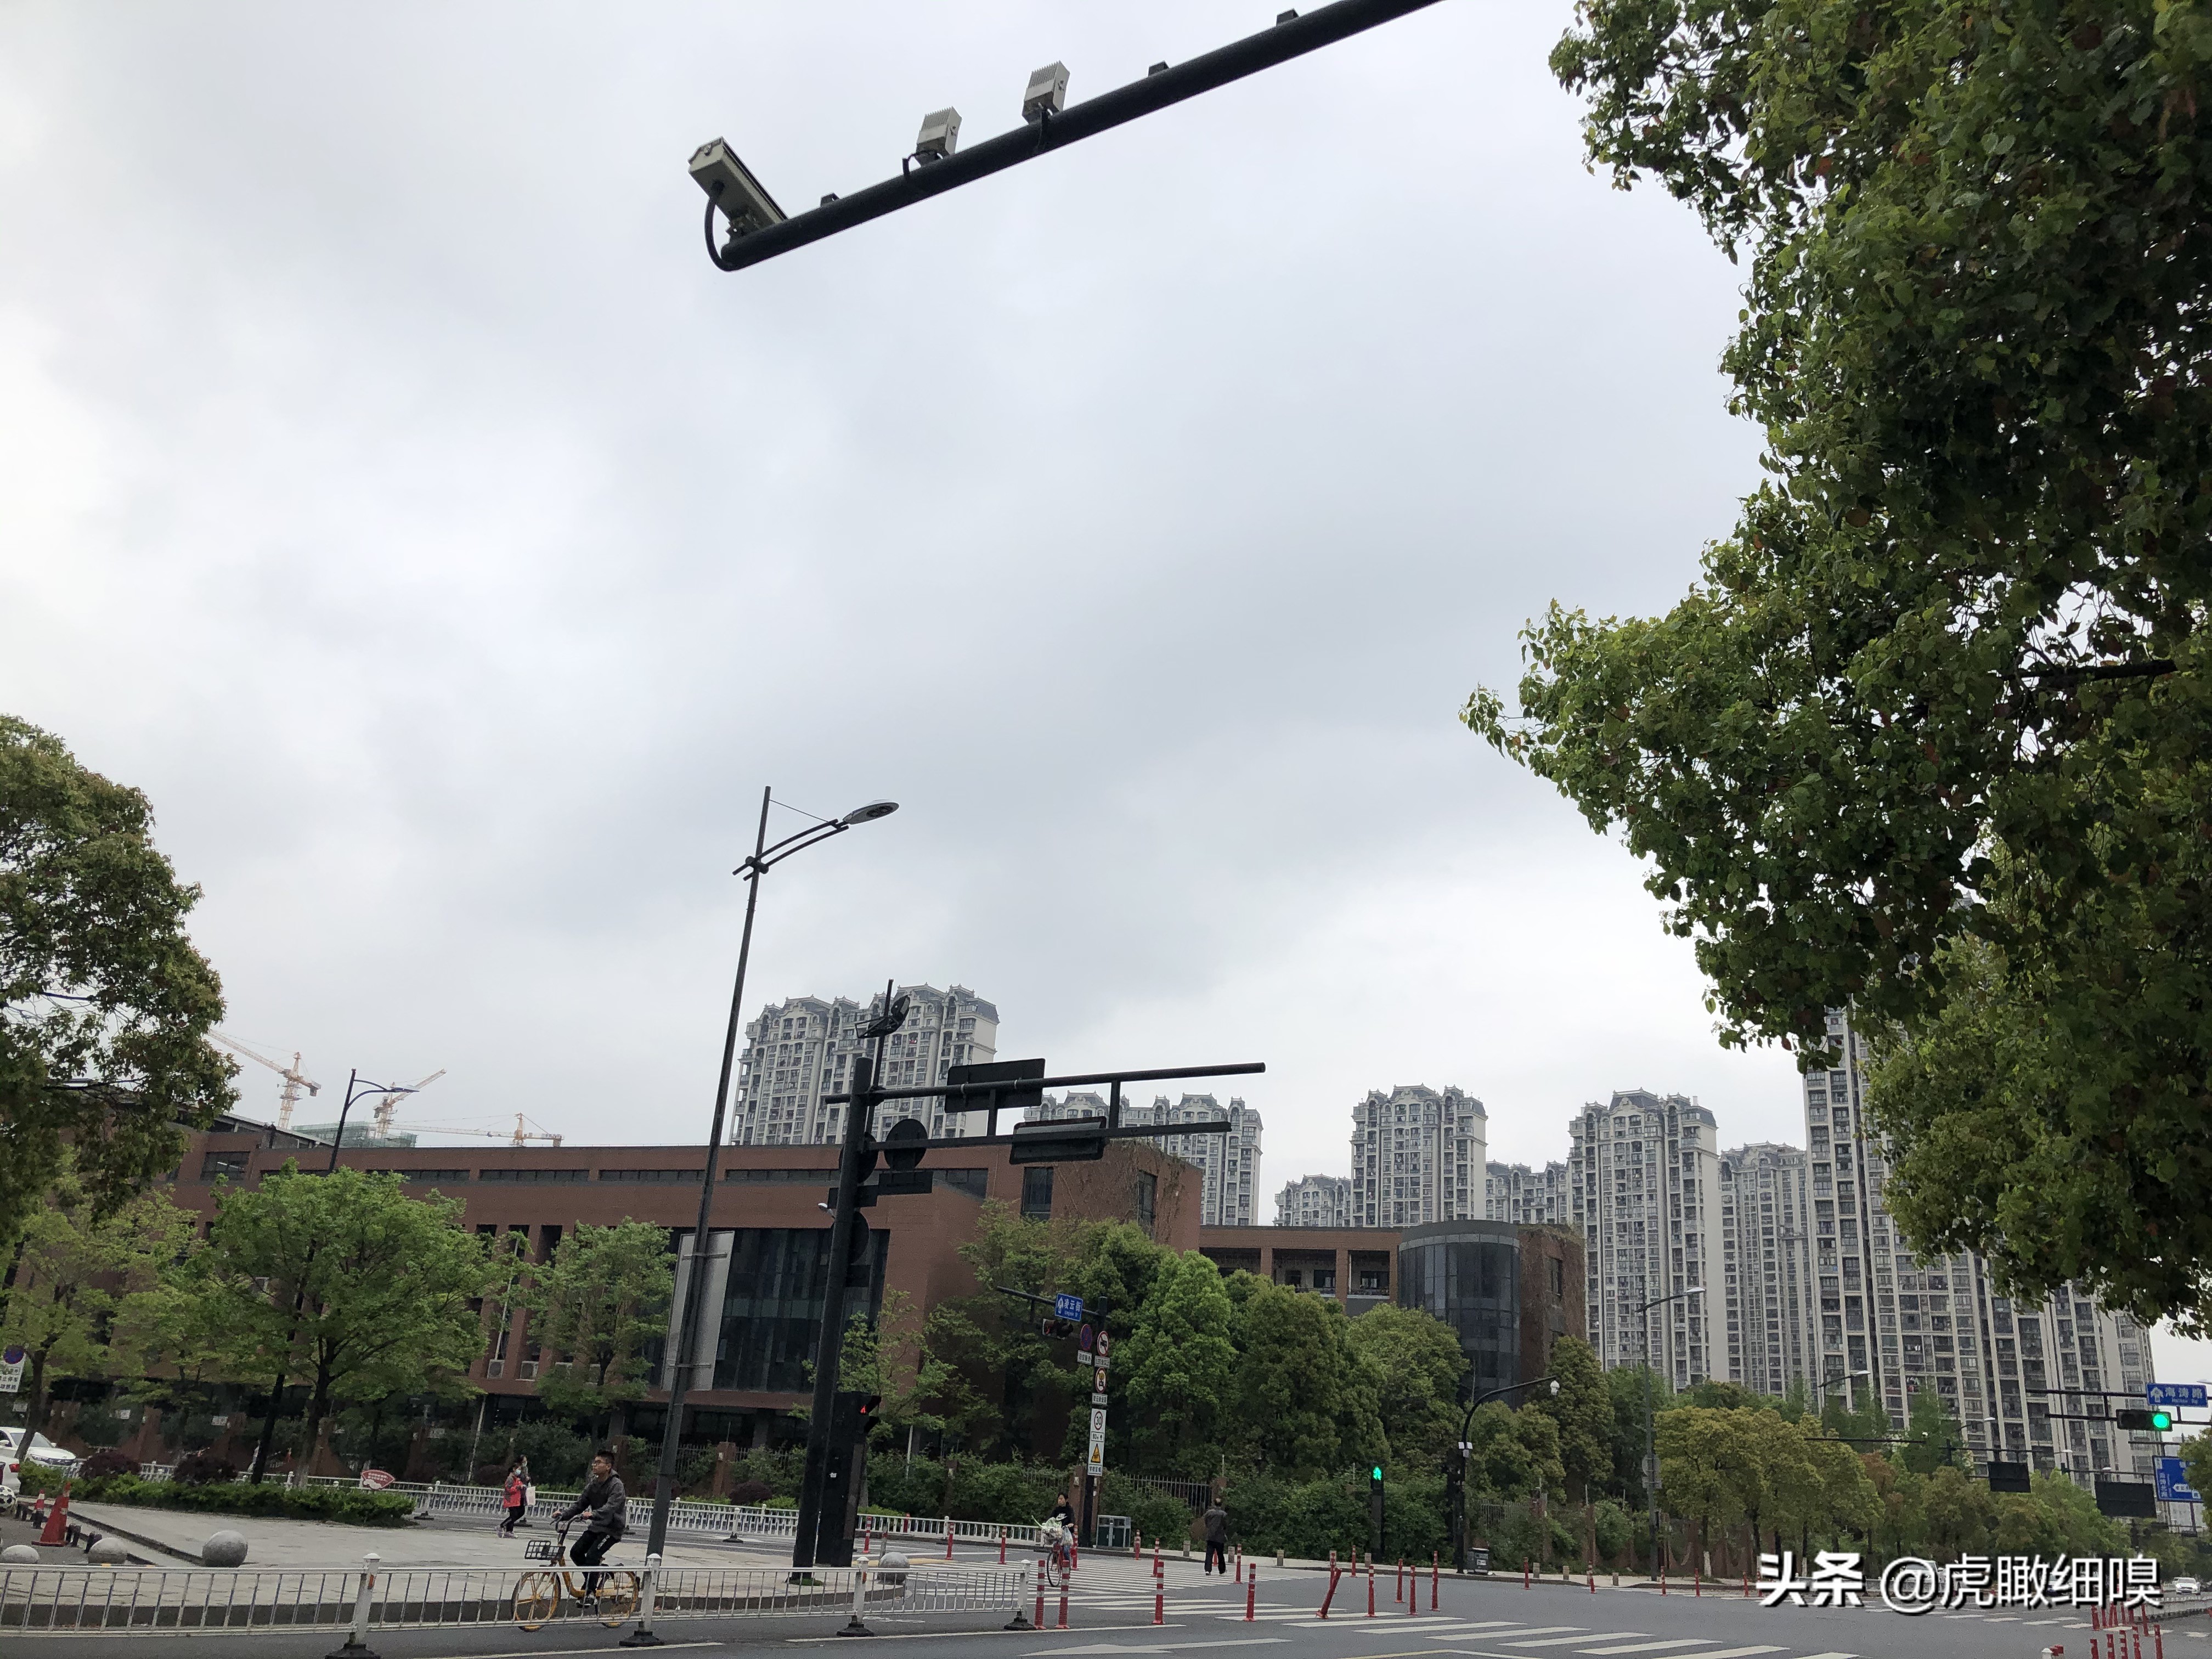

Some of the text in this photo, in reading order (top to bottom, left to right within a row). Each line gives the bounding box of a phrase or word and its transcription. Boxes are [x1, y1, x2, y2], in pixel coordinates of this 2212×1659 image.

[1064, 1298, 1081, 1312] 凌云街
[1096, 1416, 1102, 1425] 30
